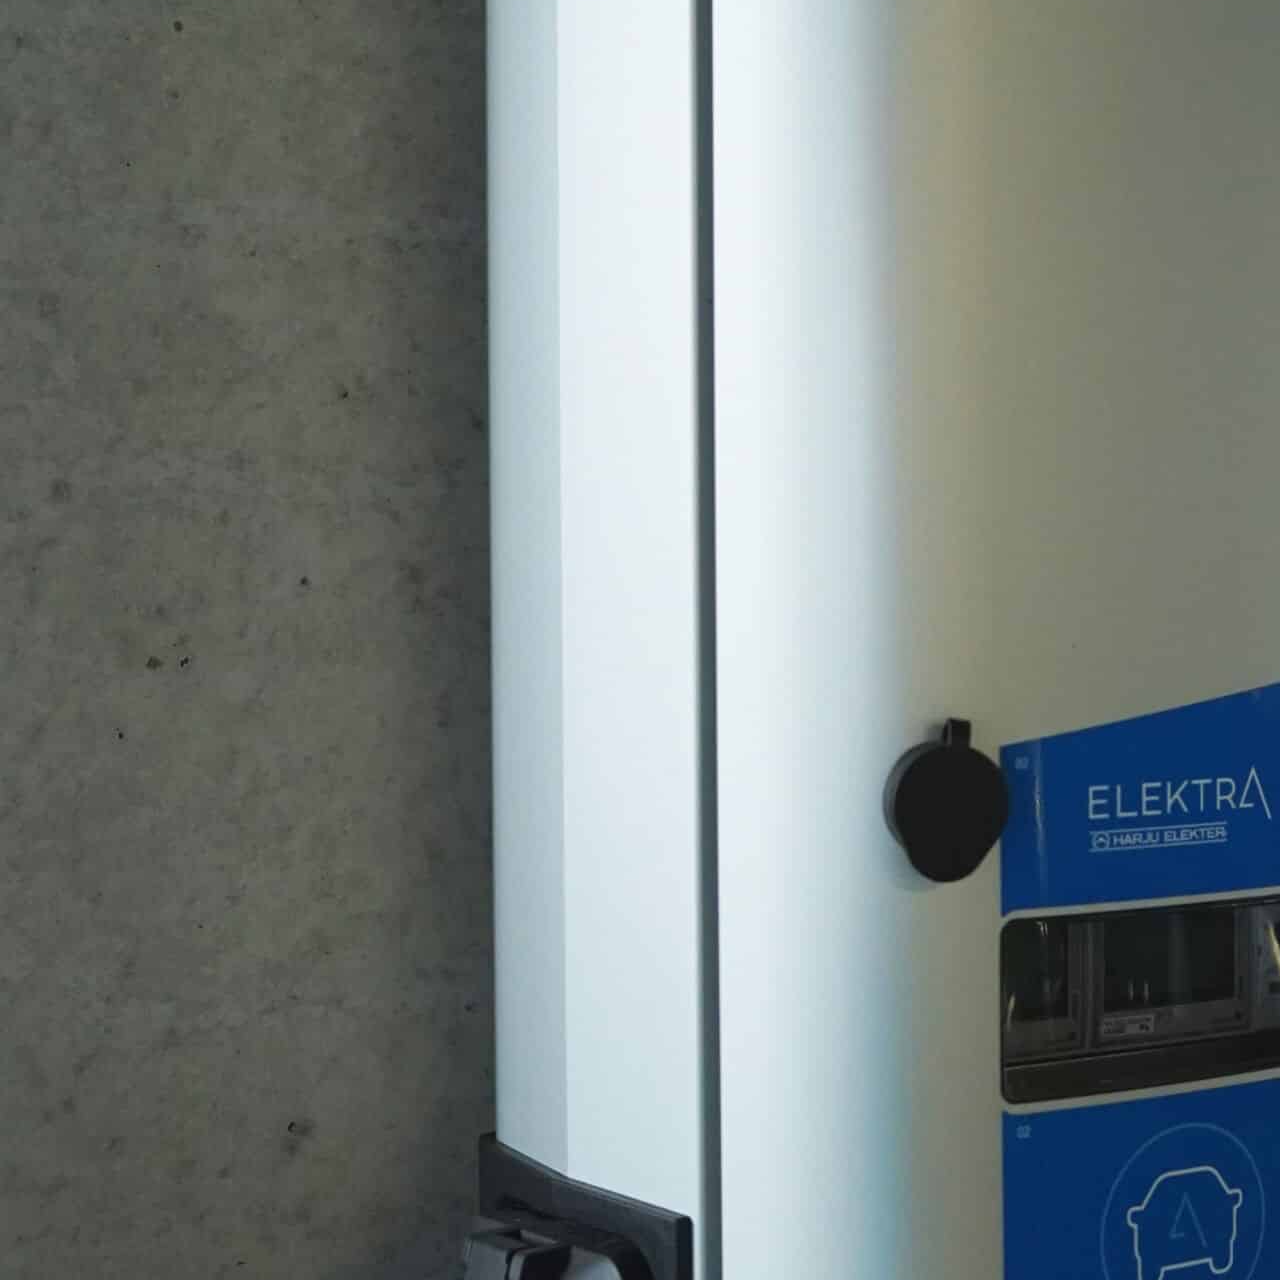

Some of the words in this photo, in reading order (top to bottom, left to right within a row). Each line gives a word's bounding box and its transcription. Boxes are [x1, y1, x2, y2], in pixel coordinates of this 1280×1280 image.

[1087, 765, 1272, 820] ELEKTRA
[1112, 830, 1160, 848] HARJU
[1163, 826, 1227, 843] ELEKTER
